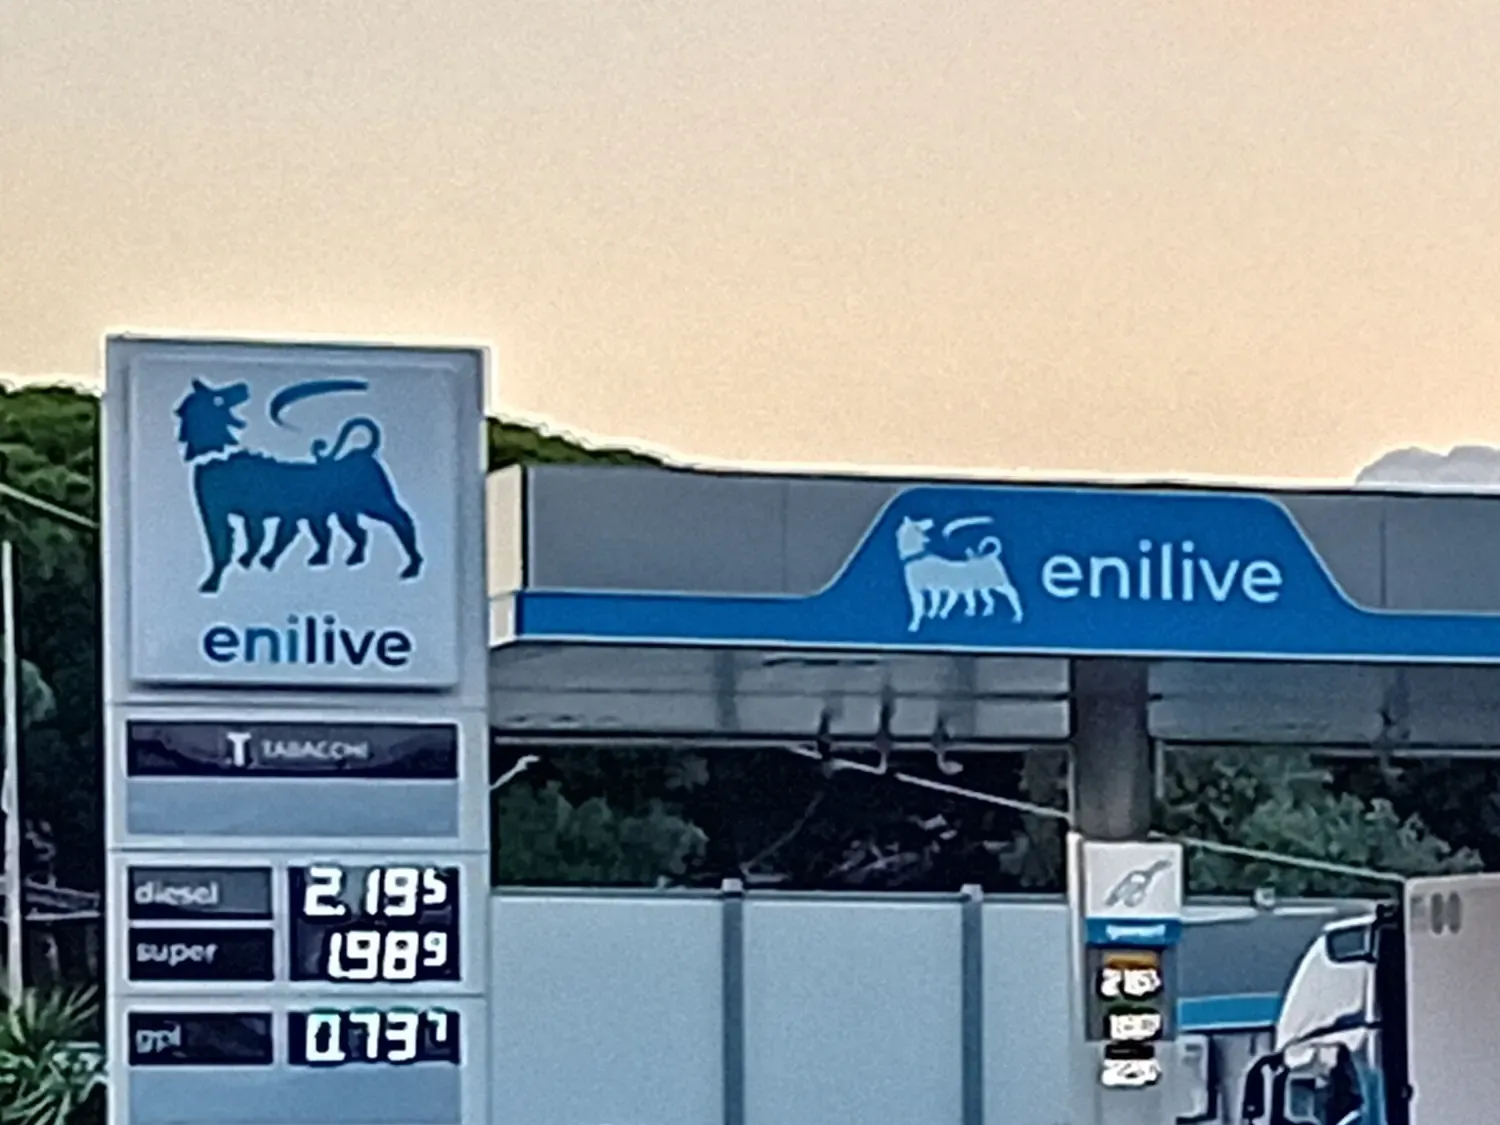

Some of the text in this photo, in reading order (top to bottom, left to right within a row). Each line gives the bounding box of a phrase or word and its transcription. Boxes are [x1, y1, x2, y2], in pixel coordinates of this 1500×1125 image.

[1041, 538, 1284, 604] enilive
[202, 614, 413, 667] enilive
[134, 880, 219, 906] diesel
[136, 942, 219, 968] super
[135, 1022, 182, 1055] gpl
